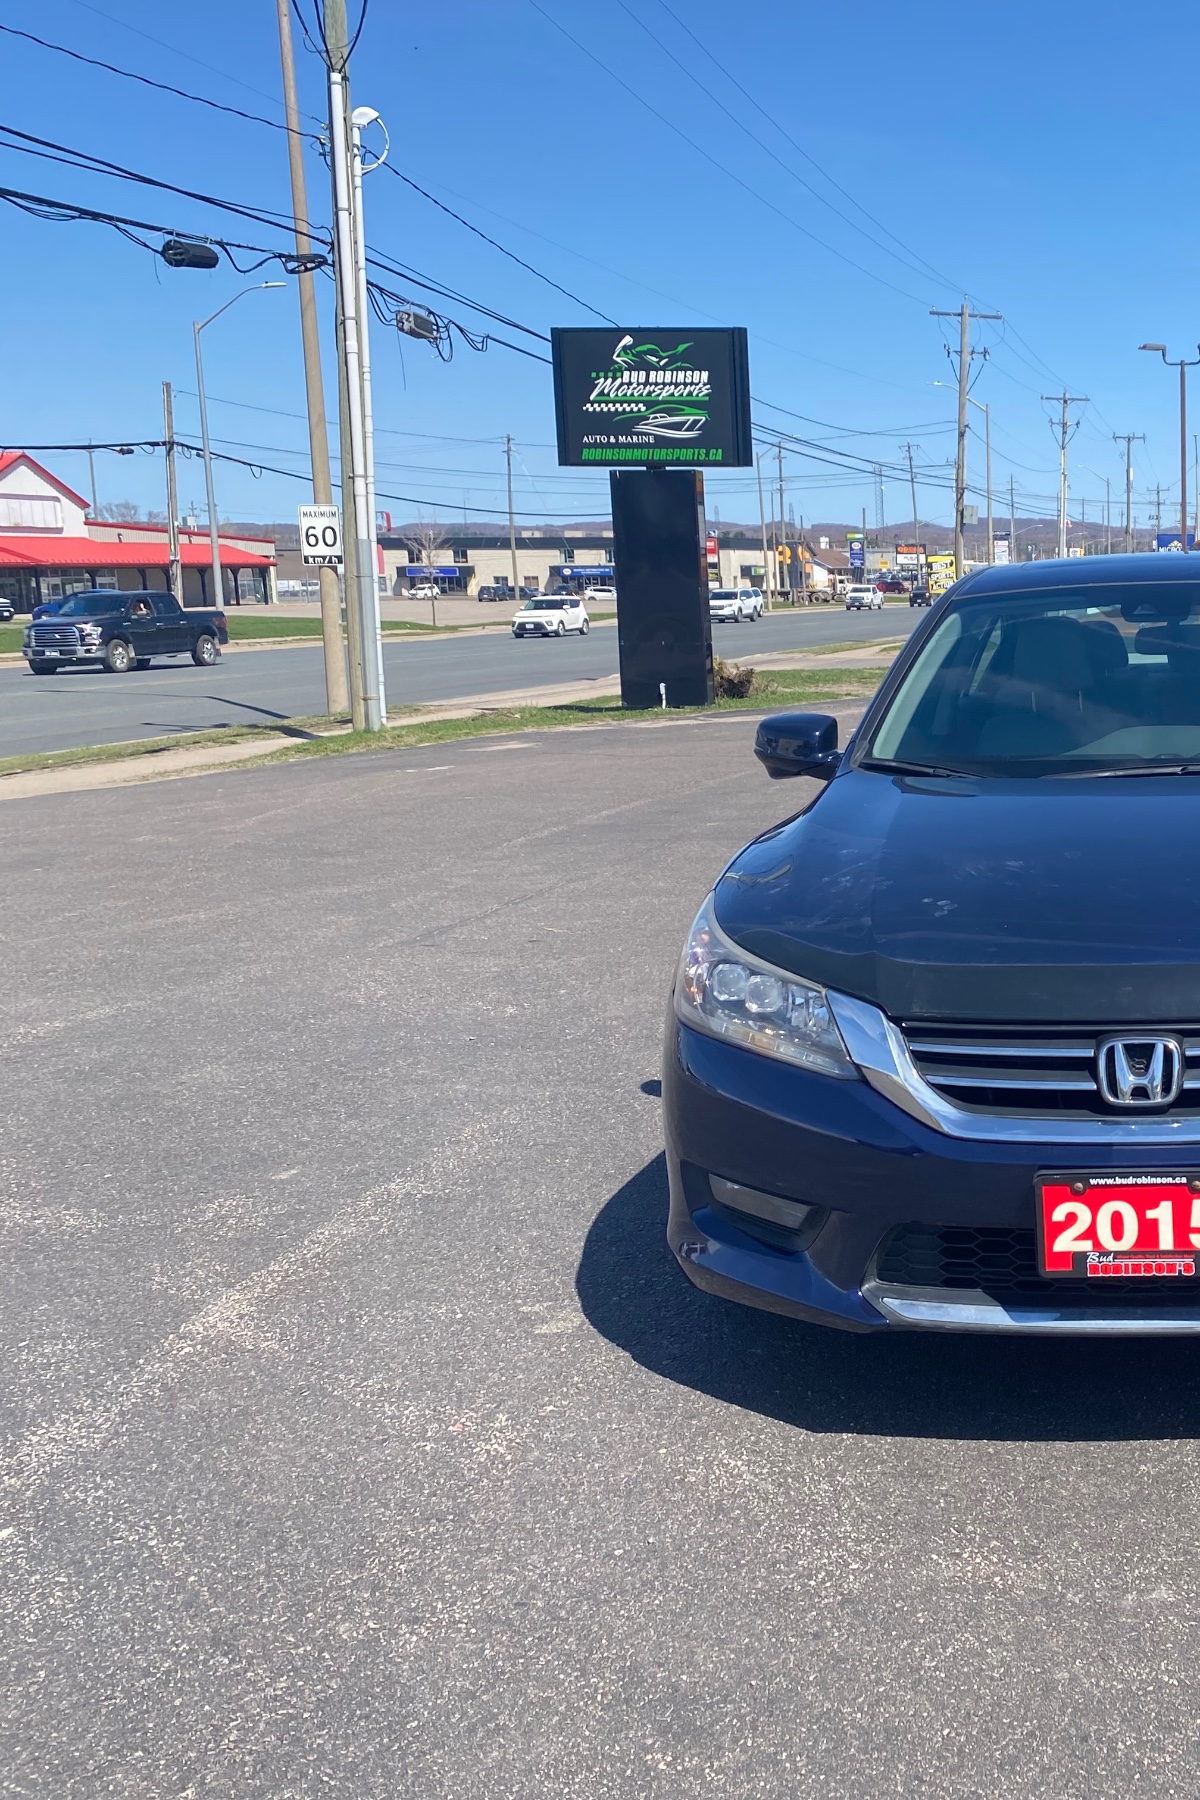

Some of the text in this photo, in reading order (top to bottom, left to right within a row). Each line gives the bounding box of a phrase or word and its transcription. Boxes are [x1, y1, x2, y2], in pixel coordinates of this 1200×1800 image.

[622, 371, 709, 383] BUD ROBINSON
[590, 377, 713, 400] Motorsports
[582, 435, 607, 443] AUTO
[618, 435, 655, 443] MARINE
[582, 448, 723, 461] ROBINSONMOTORSPORTS.CA
[305, 526, 337, 547] 60
[308, 556, 339, 564] km/h
[932, 560, 951, 571] BEST
[931, 572, 954, 581] SPORTS
[1089, 1175, 1187, 1185] www.budrobinson.ca
[1087, 1251, 1114, 1263] Bud
[1087, 1262, 1196, 1277] ROBINSON'S
